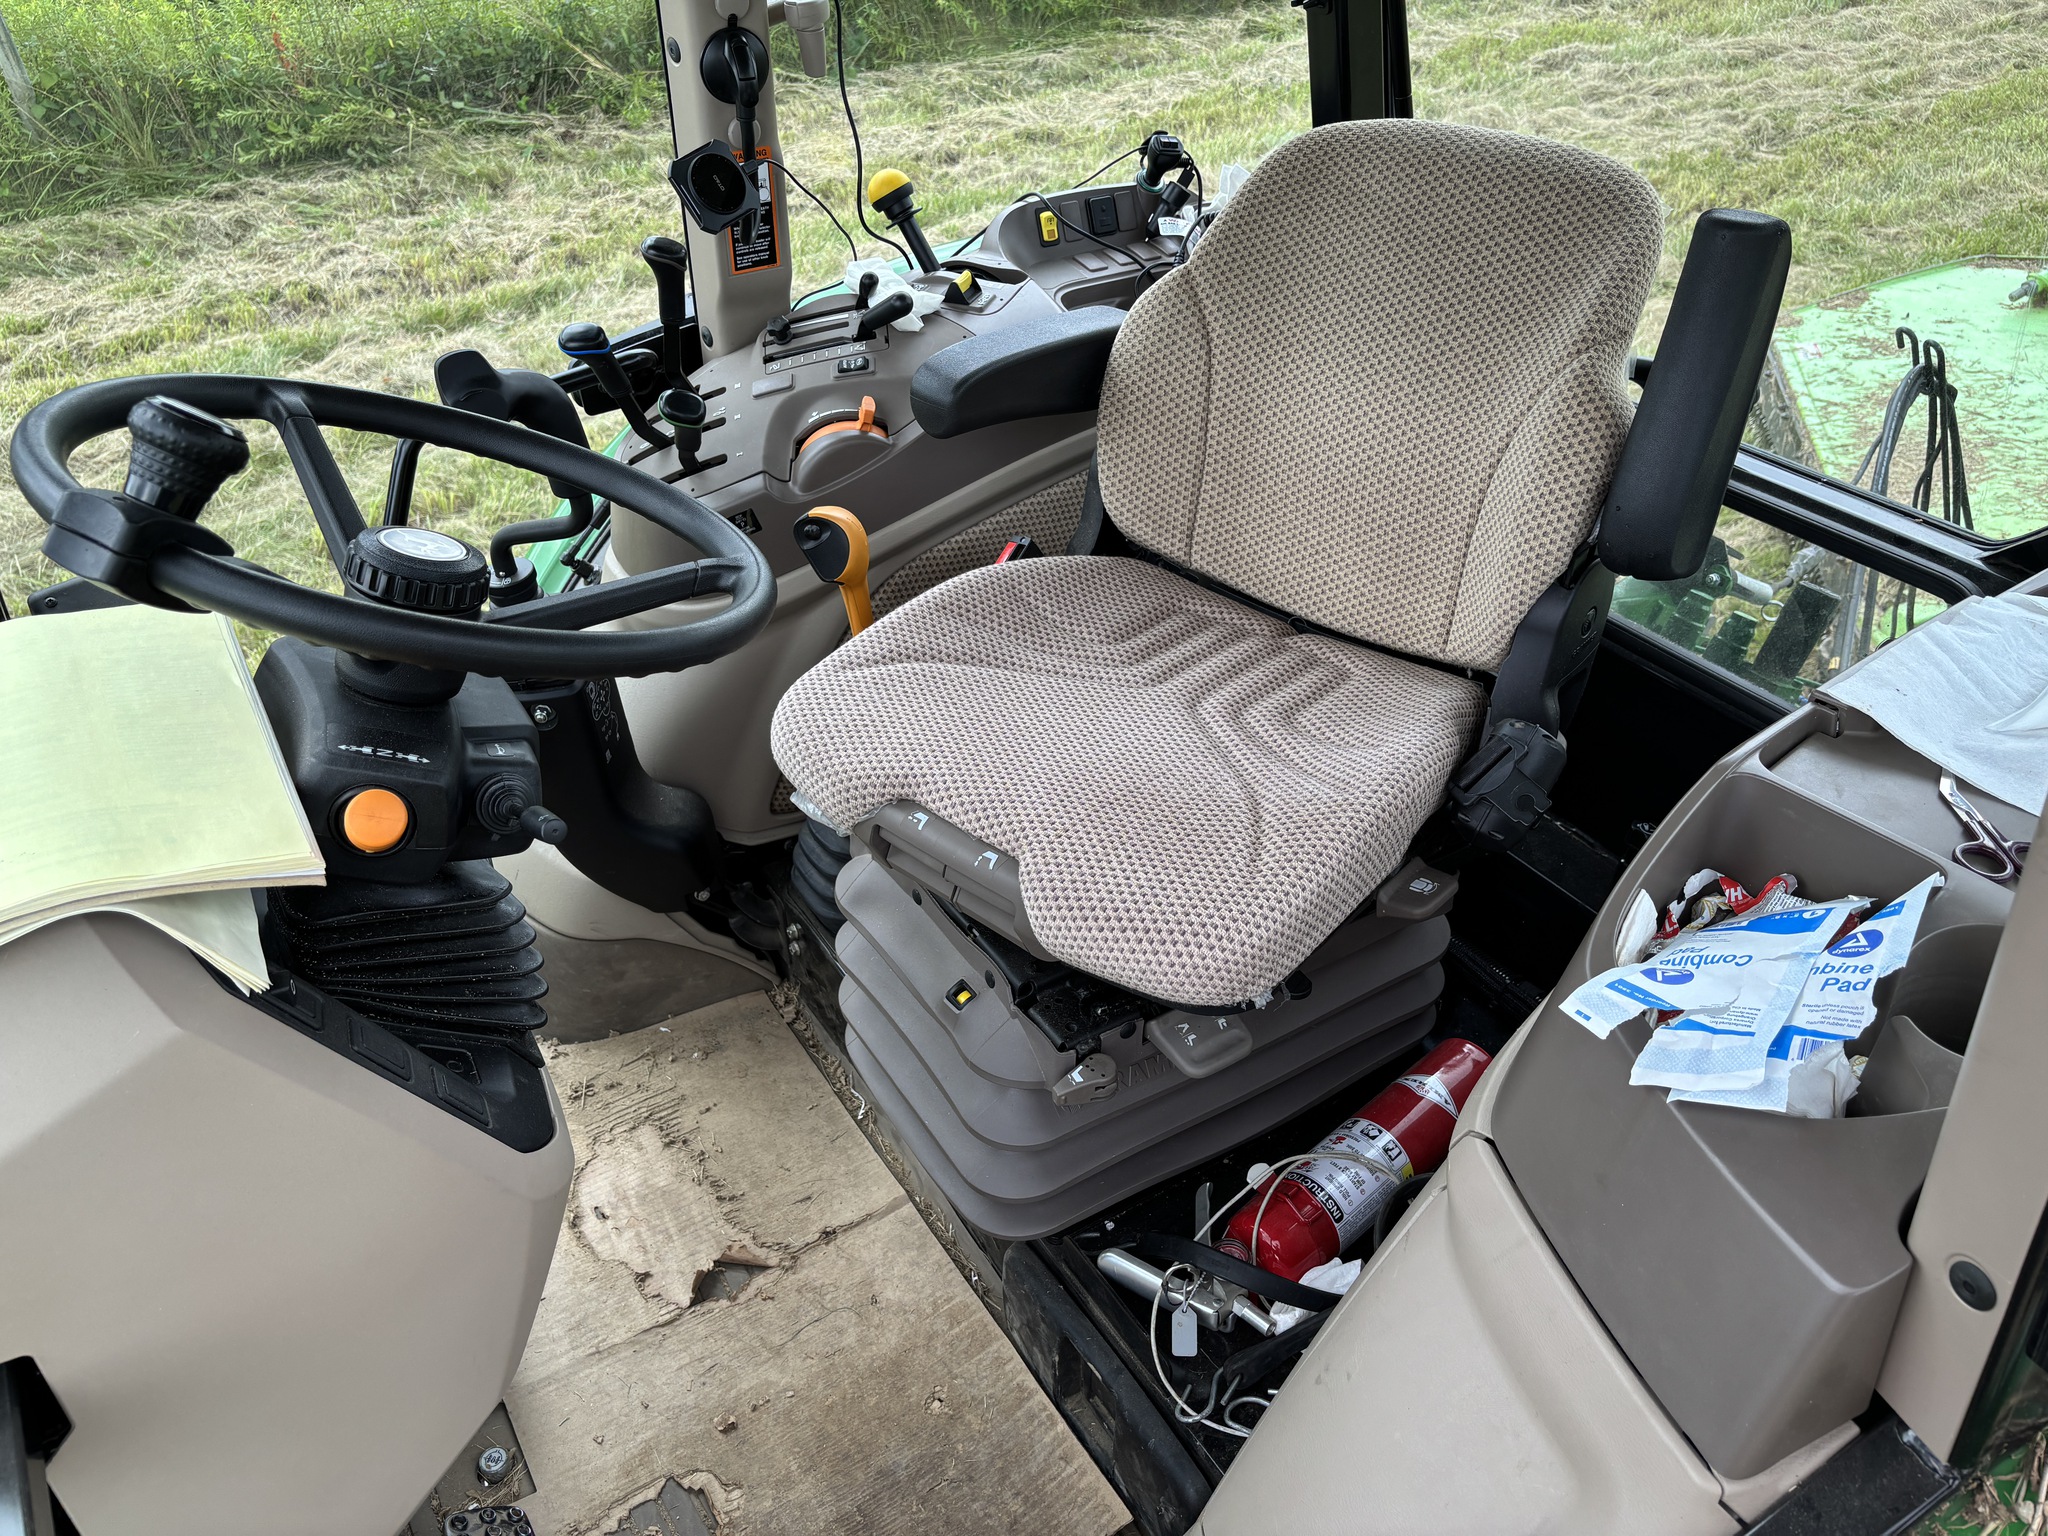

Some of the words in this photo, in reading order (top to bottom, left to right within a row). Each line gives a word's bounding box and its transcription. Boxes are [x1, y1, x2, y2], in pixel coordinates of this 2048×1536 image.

[1660, 954, 1753, 969] Combine
[1820, 978, 1872, 992] Pad
[1285, 1172, 1342, 1219] INSTRUCTIO
